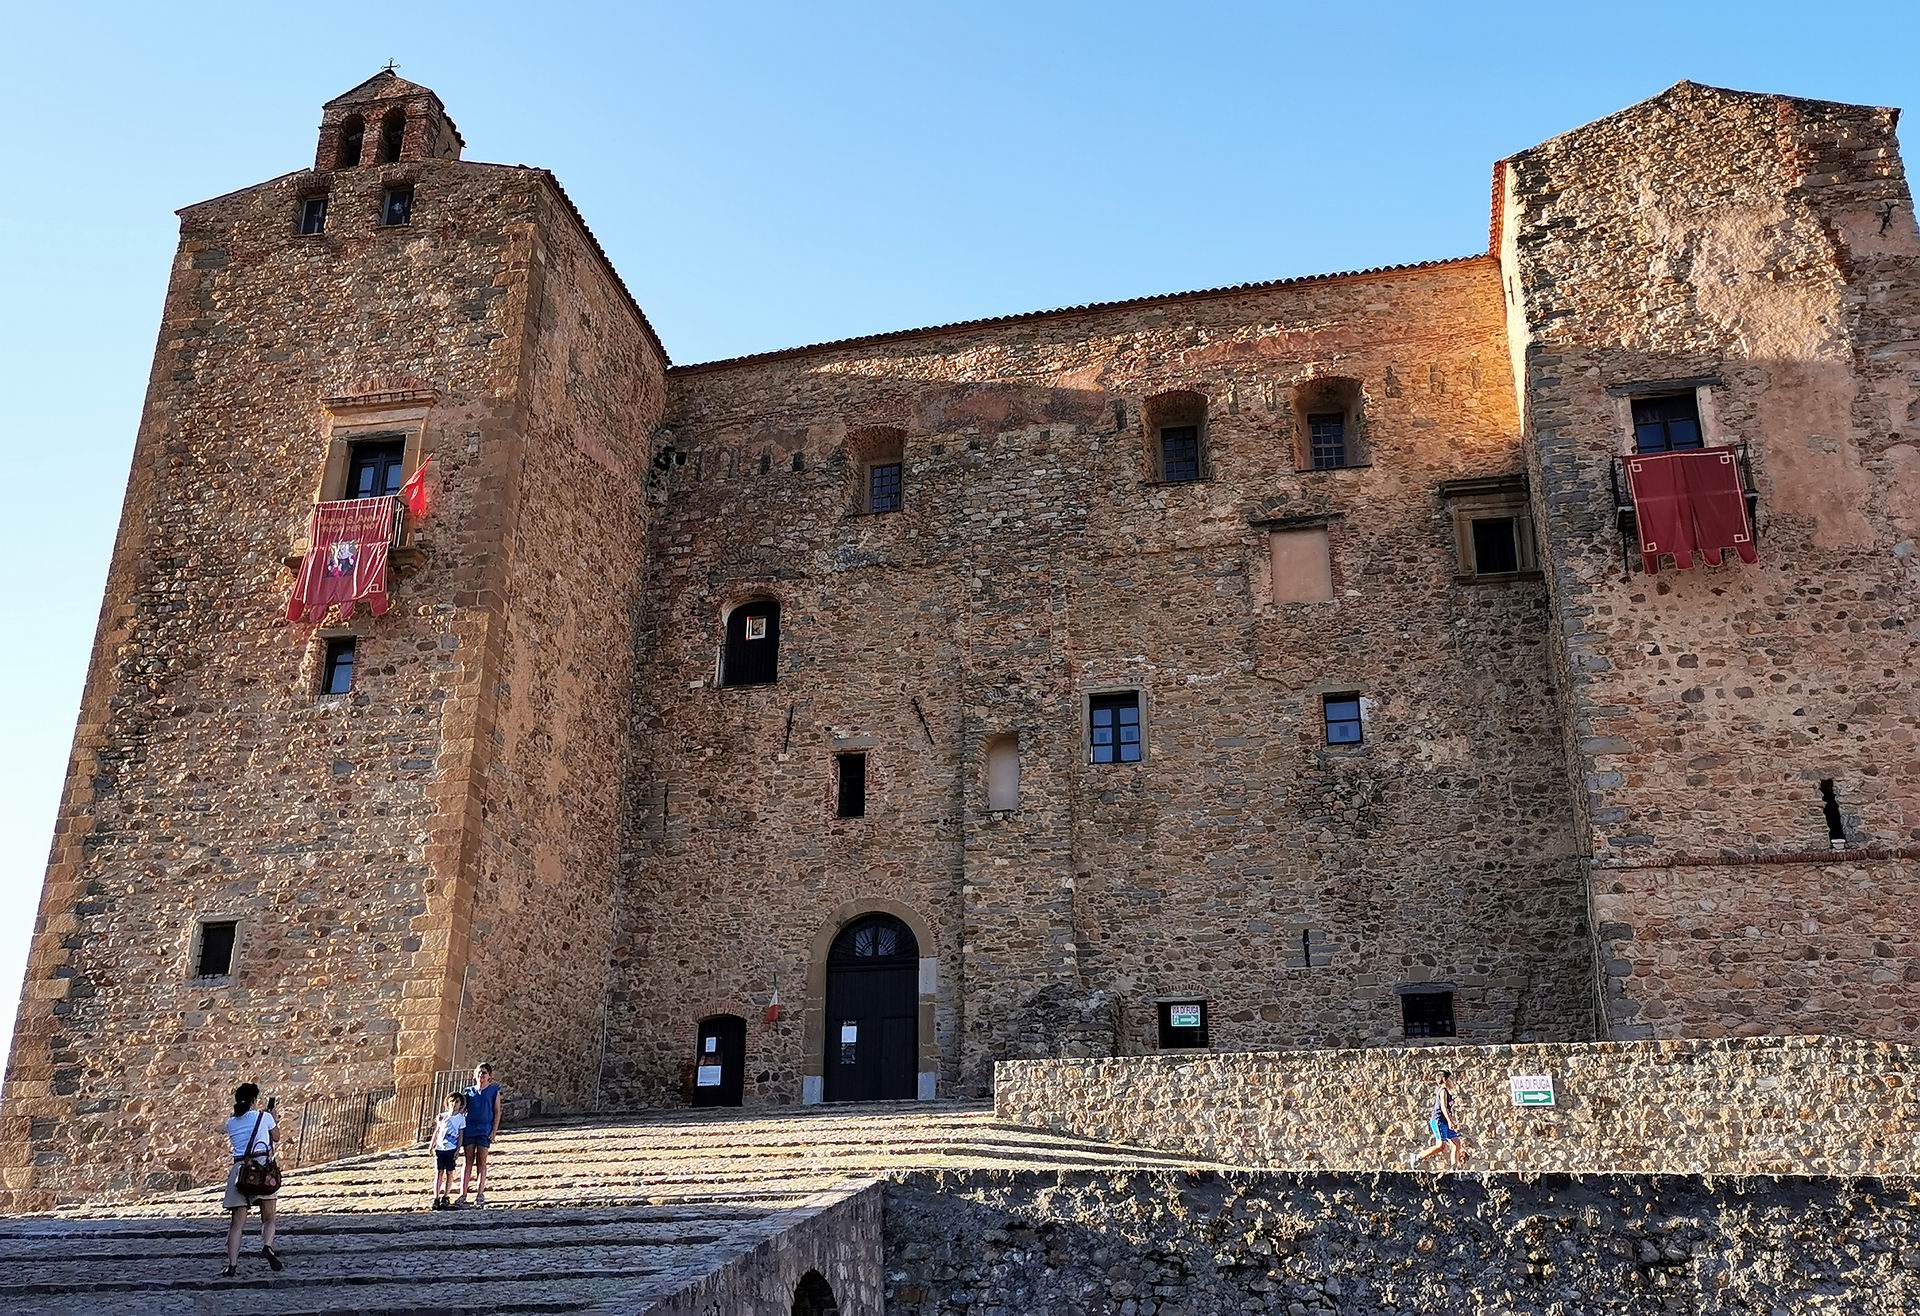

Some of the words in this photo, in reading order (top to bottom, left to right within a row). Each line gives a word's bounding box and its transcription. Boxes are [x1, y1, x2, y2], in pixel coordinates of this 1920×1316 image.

[1186, 1006, 1198, 1014] FUGA
[1512, 1078, 1525, 1089] VIA
[1526, 1079, 1532, 1089] DI
[1533, 1079, 1550, 1089] FUGA
